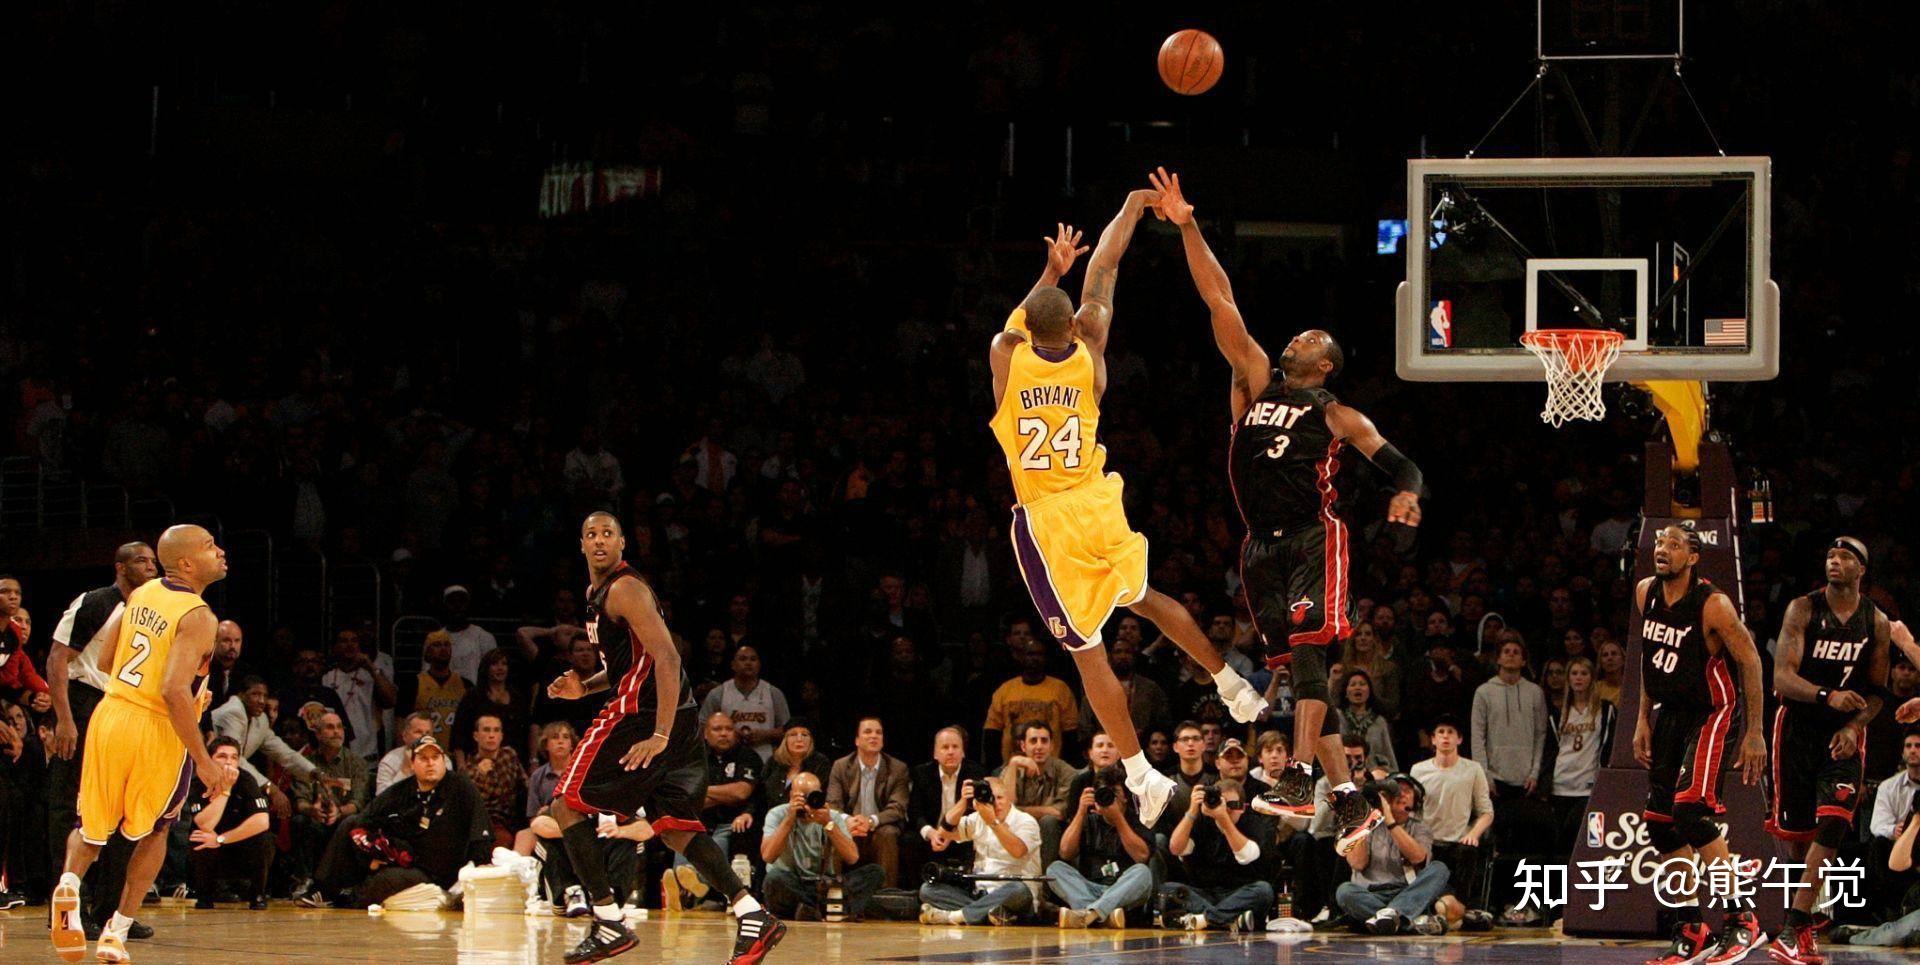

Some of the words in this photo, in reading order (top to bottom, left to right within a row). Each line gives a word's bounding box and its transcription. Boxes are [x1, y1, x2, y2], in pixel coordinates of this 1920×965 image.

[1020, 385, 1082, 410] BRYANT
[1244, 402, 1313, 430] HEAT
[1018, 414, 1083, 471] 24
[1266, 434, 1291, 459] 3
[129, 606, 169, 638] FISHER
[1642, 619, 1693, 649] HEAT
[117, 630, 152, 688] 2
[1652, 647, 1679, 674] 40
[1812, 636, 1869, 662] HEAT
[1839, 665, 1854, 688] 7
[1573, 735, 1584, 752] 8
